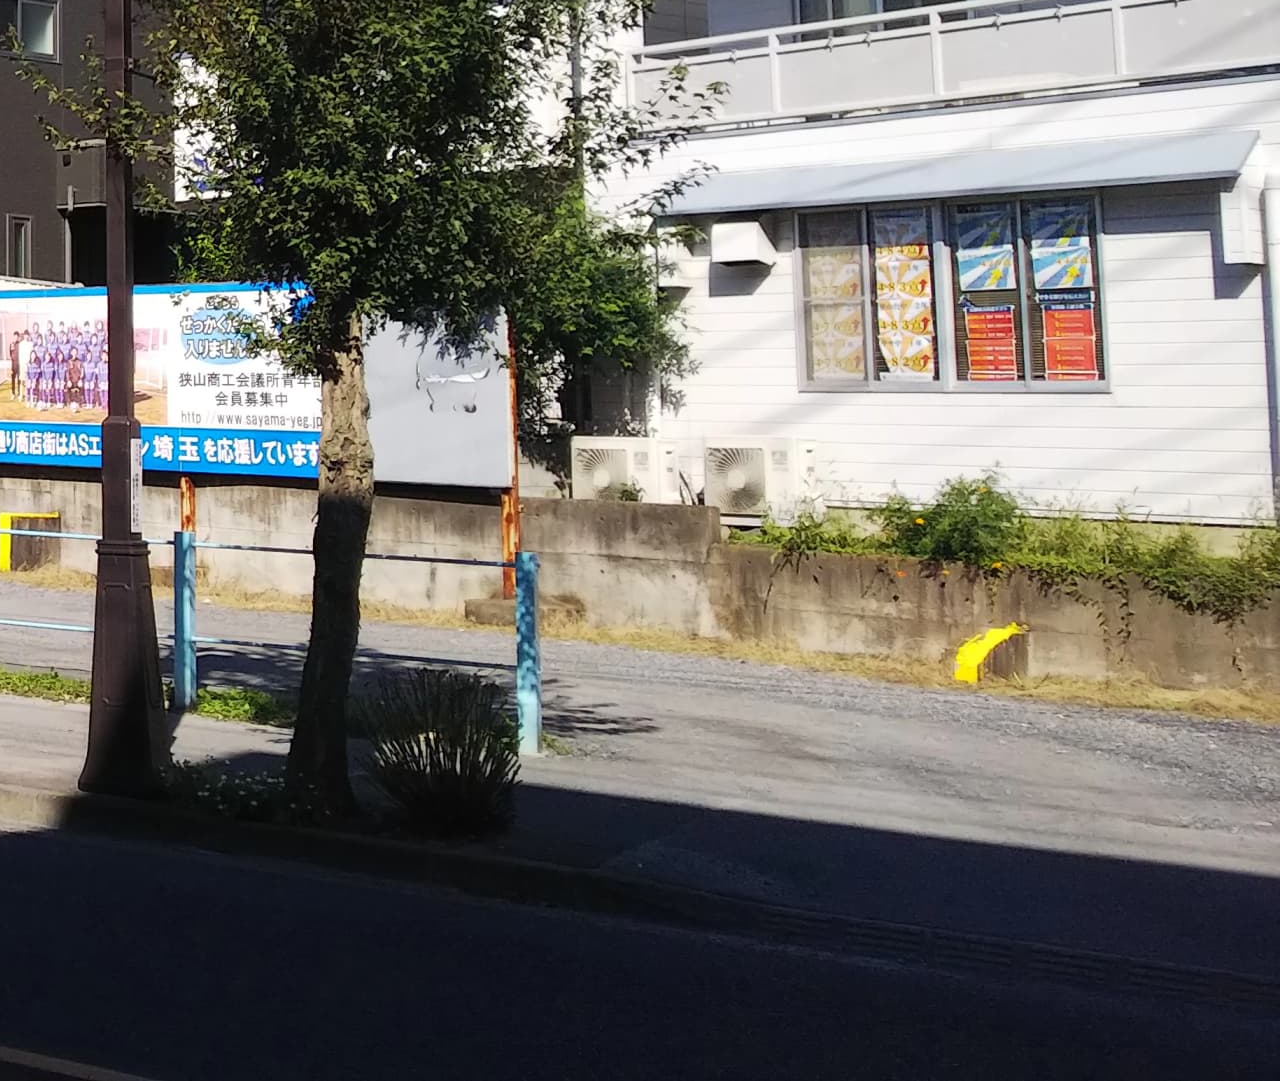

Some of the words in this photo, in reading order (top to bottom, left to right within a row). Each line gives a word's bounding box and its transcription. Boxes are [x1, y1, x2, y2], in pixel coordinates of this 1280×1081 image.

[215, 391, 288, 407] 会員募集中
